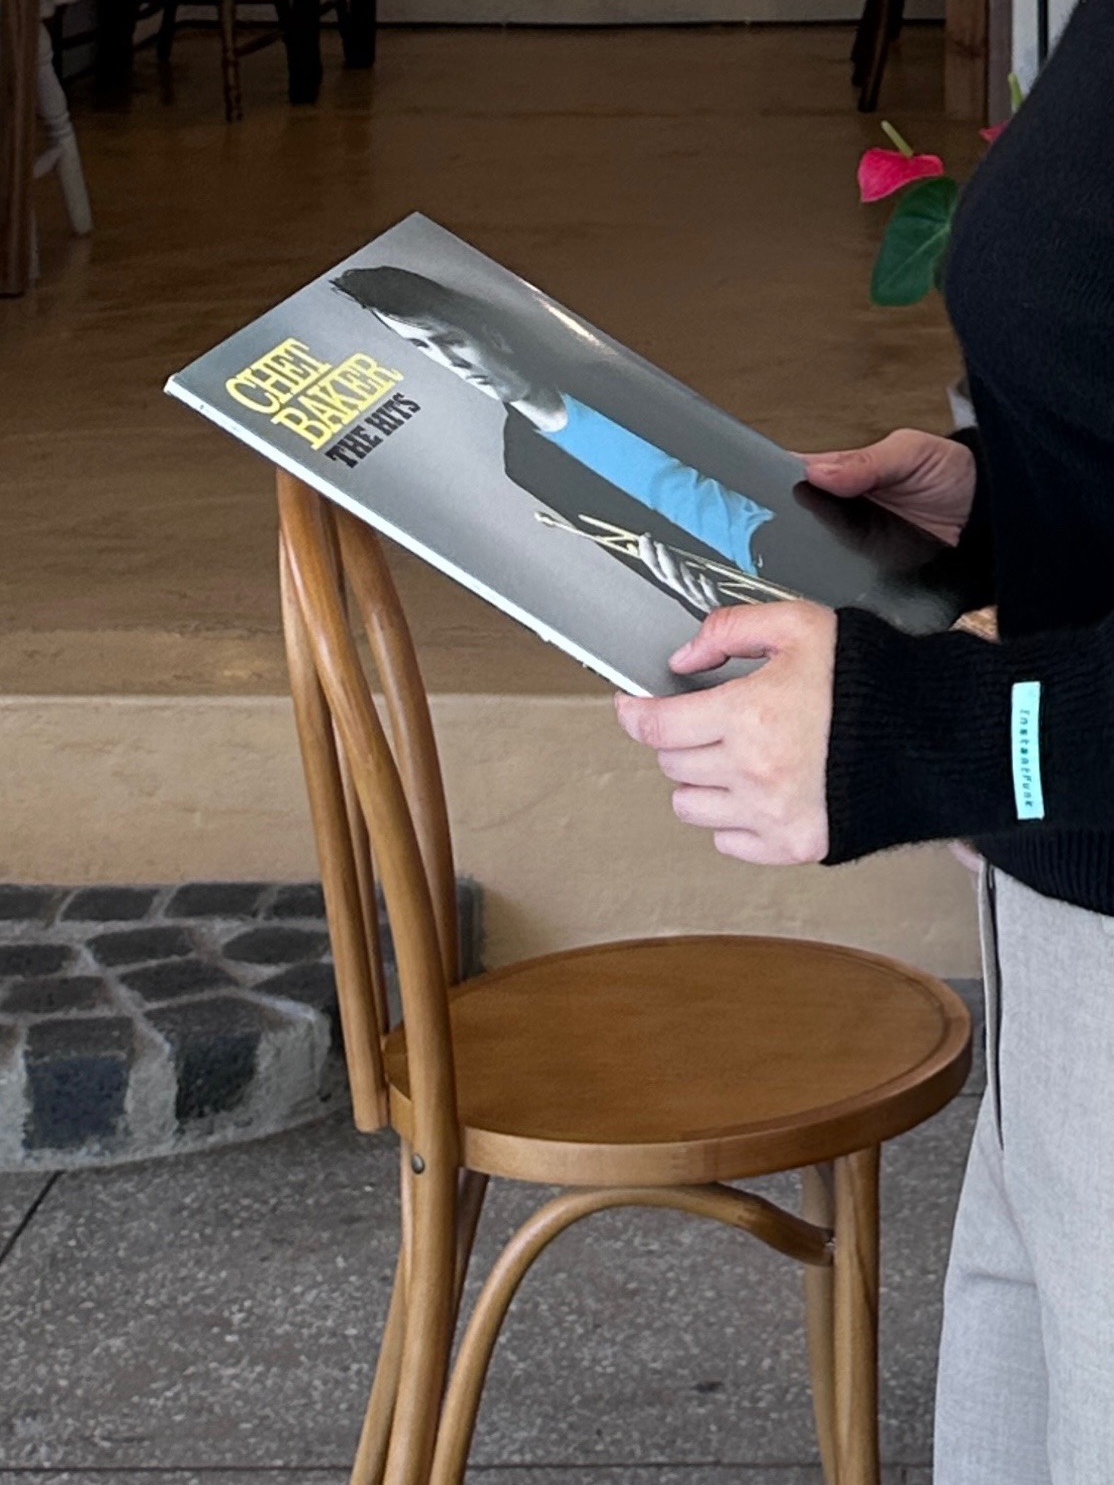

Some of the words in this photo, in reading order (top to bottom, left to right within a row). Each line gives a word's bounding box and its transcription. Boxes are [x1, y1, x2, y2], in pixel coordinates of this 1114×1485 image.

[225, 337, 332, 413] CHET
[270, 352, 404, 450] BAKER
[325, 426, 383, 468] THE
[365, 392, 421, 436] HITS
